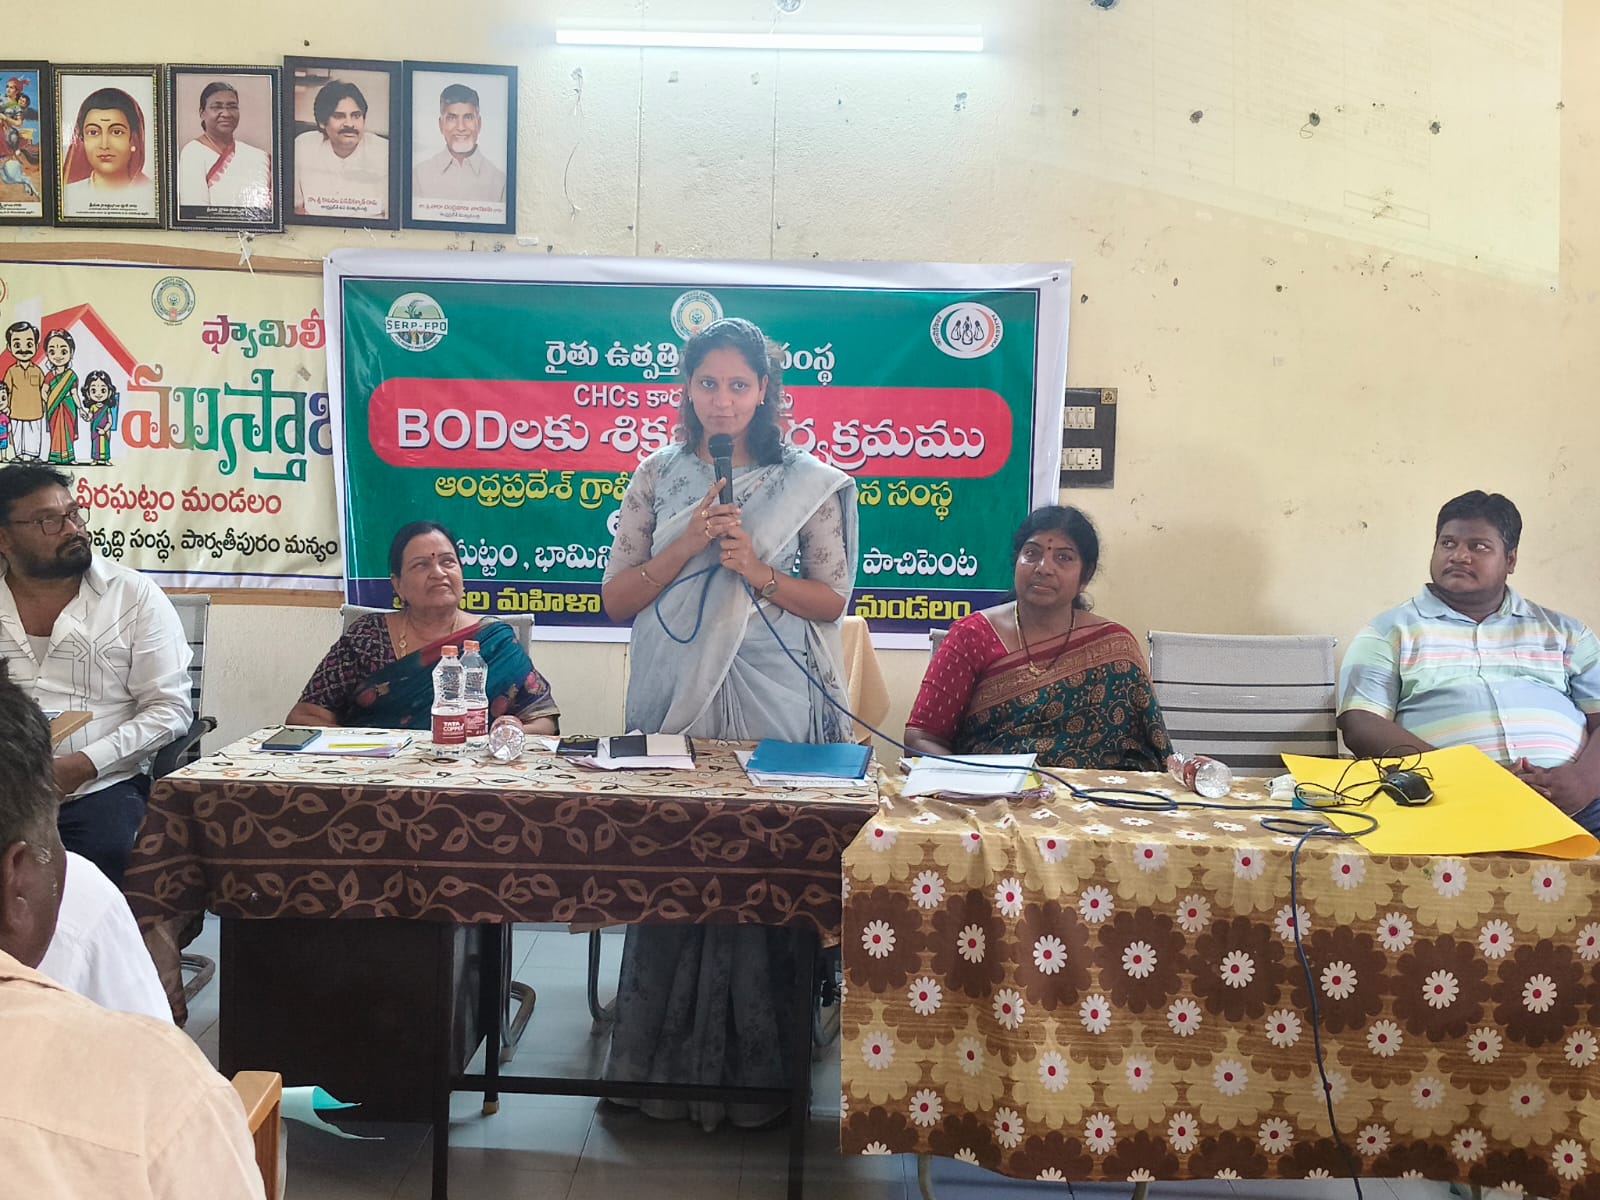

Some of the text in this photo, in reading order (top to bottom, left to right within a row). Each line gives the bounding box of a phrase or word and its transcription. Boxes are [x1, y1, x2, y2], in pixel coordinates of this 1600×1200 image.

[202, 308, 326, 359] ఫ్యామిలీ
[386, 319, 448, 332] SERP-FPO
[545, 340, 599, 374] రైతు
[605, 341, 681, 380] ఉత్పత్తి
[574, 384, 640, 408] CHCs
[397, 409, 590, 453] BODలకు
[76, 477, 283, 522] వీరఘట్టం మండలం
[435, 469, 576, 508] ఆంధ్రప్రదేశ్
[181, 528, 281, 559] పార్వతీపురం
[285, 535, 338, 563] మన్యం
[863, 548, 978, 576] పాచిపెంట
[497, 588, 601, 613] మహిళా
[855, 594, 971, 621] మండలం
